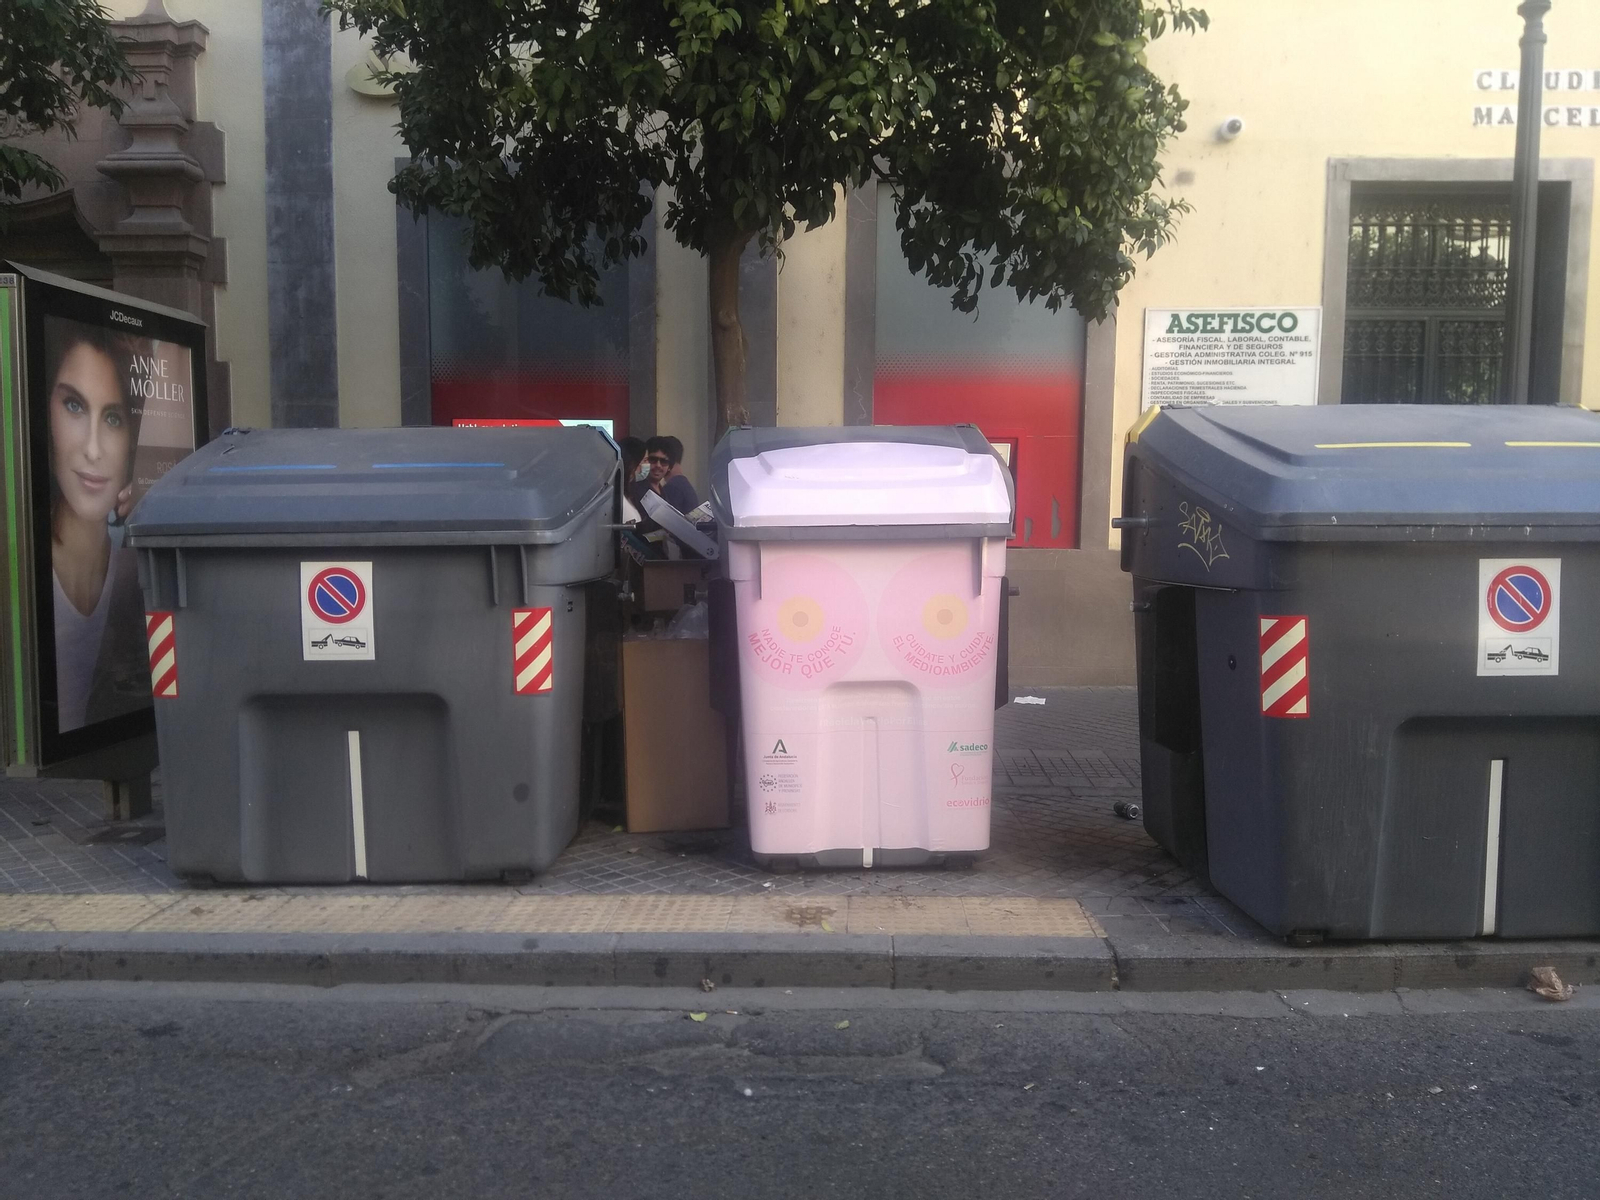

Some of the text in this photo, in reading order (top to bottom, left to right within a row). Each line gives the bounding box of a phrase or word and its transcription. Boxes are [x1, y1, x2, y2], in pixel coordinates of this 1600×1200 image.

[1476, 71, 1600, 90] CLUDI
[1473, 106, 1600, 126] MACEL
[110, 310, 143, 327] JCDecaux
[1166, 312, 1298, 334] ASEFISCO
[130, 354, 168, 378] ANNE
[130, 374, 184, 402] MÖLLER
[762, 626, 841, 663] NADIE TE CONOCE
[893, 636, 904, 652] EL
[948, 654, 956, 663] Y
[960, 631, 985, 658] CUIDA
[748, 632, 792, 674] MEJOR
[801, 656, 835, 679] QUE
[960, 743, 988, 752] sadeco
[946, 797, 990, 807] ecovidrio
